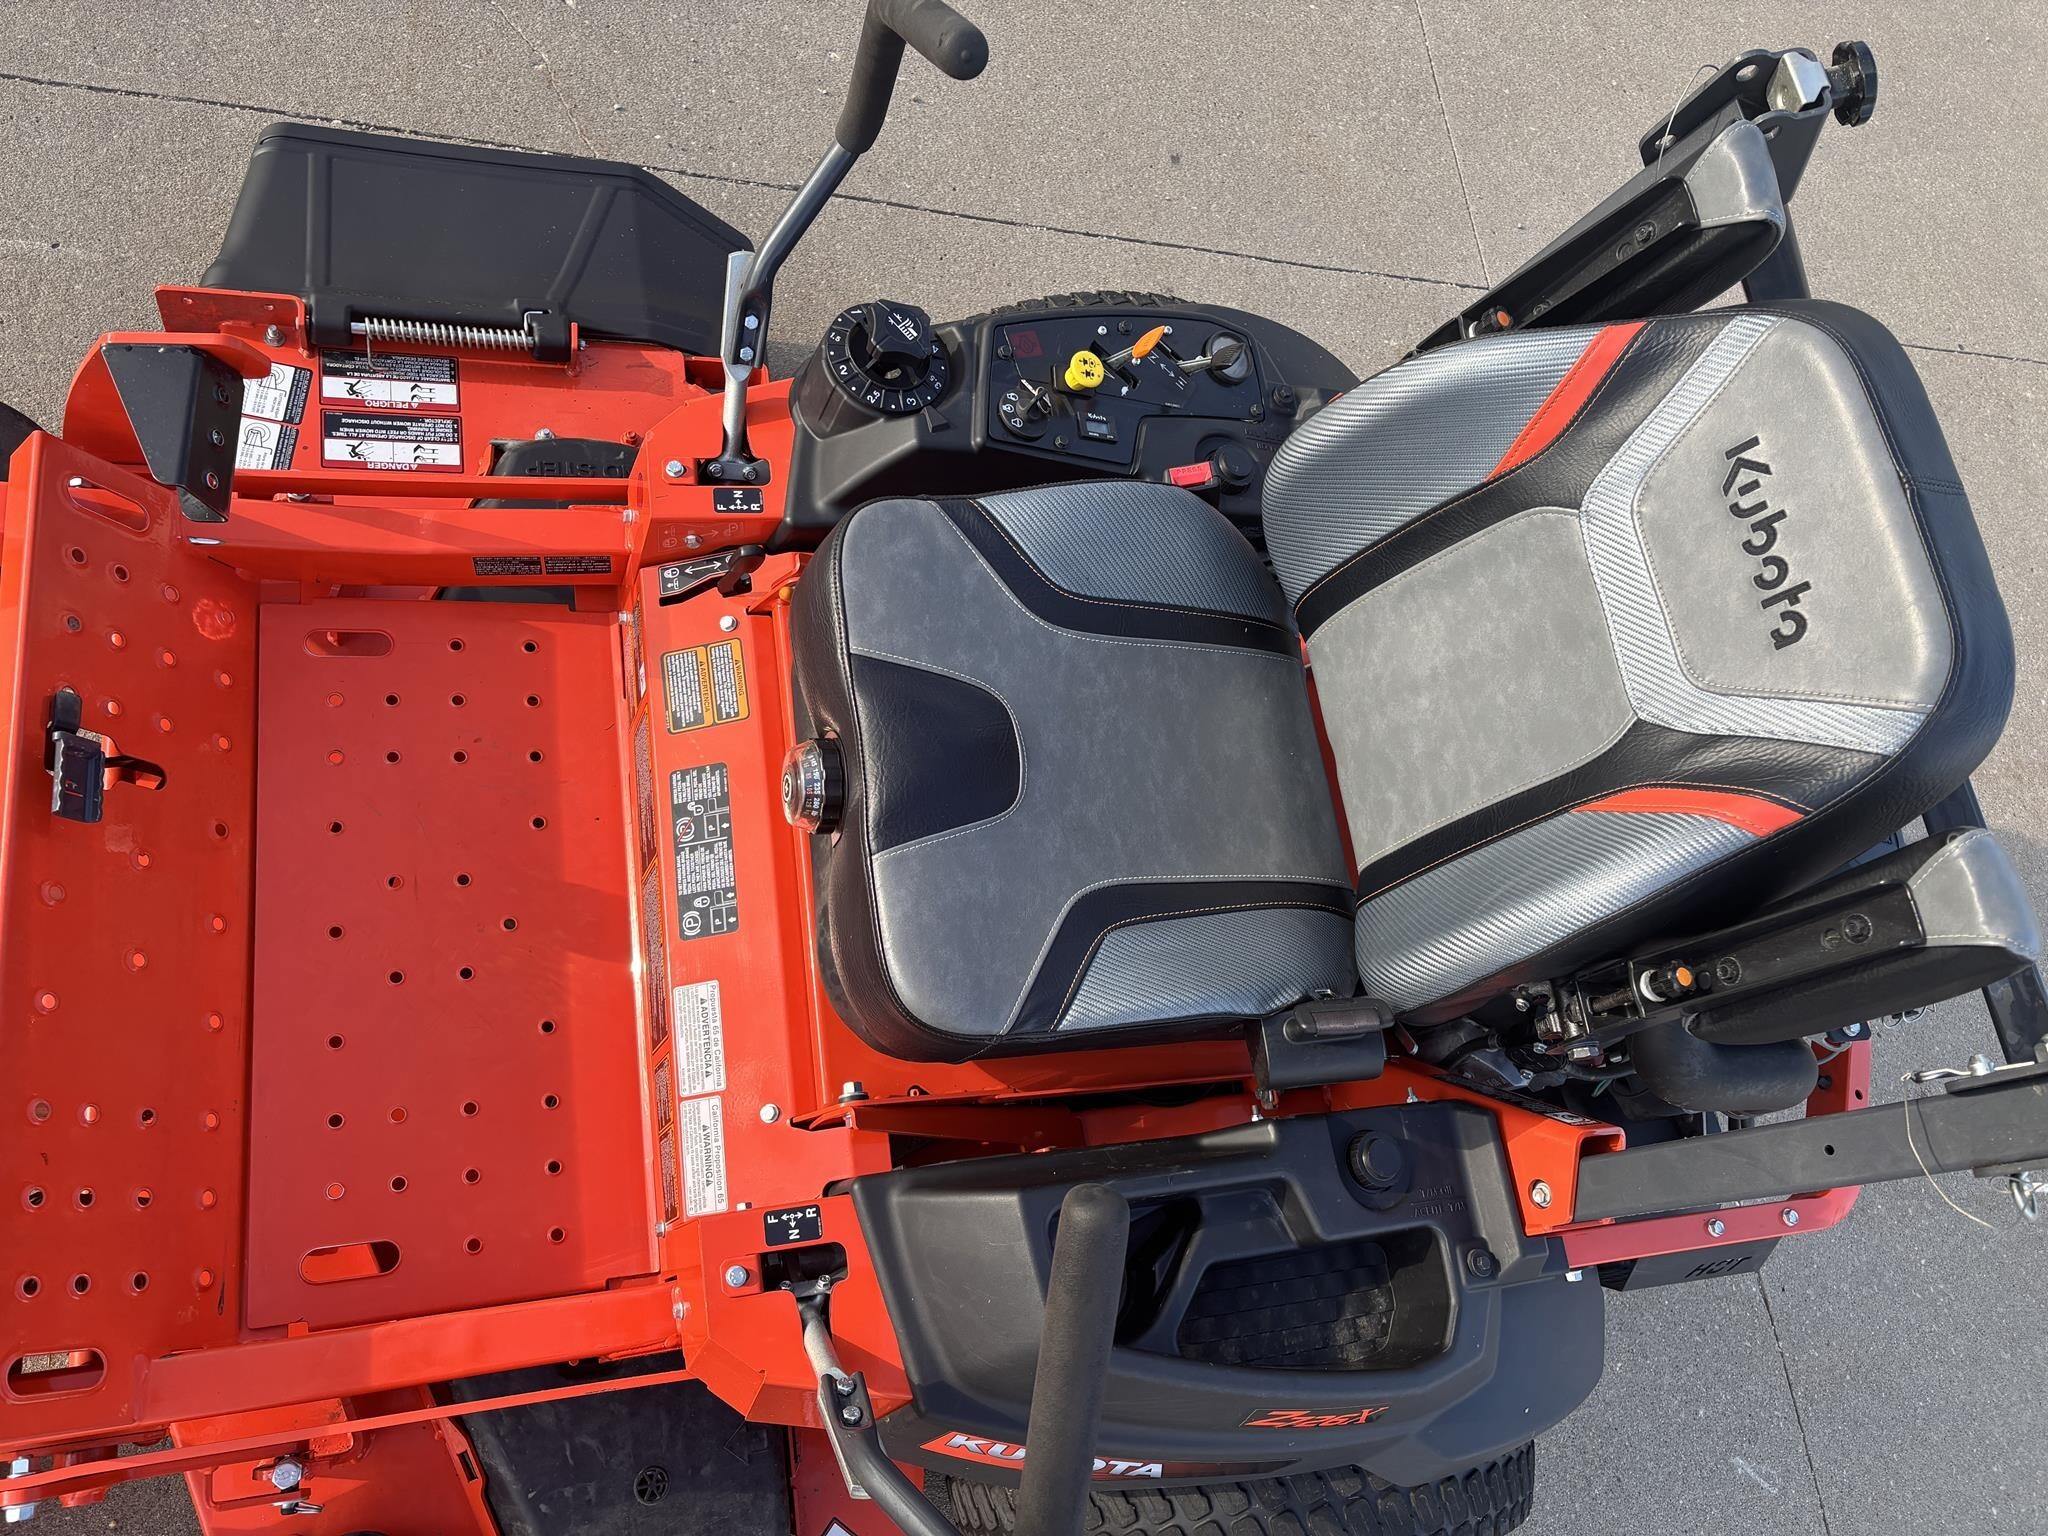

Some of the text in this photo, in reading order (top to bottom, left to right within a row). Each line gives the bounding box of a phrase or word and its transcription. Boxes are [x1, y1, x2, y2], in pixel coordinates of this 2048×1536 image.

[829, 331, 842, 342] 1.5
[839, 364, 849, 375] 2
[866, 390, 881, 404] 2.5
[906, 397, 917, 406] 3
[365, 400, 409, 409] PELIGRO
[367, 462, 411, 471] DANGER
[733, 490, 744, 498] N
[716, 503, 727, 511] F
[750, 503, 761, 511] R
[1722, 435, 1812, 651] Kubota
[735, 665, 745, 697] WARNING
[699, 667, 711, 713] ADVERTENCIA
[684, 917, 698, 927] P
[700, 1006, 711, 1069] ADVERTENCIA
[708, 984, 722, 1087] Propuesta 65 de California
[702, 1132, 712, 1179] WARNING
[711, 1104, 724, 1204] California Proposition 65
[805, 1207, 817, 1218] R
[767, 1215, 779, 1224] F
[788, 1229, 801, 1240] N
[946, 1434, 1163, 1479] KUTA
